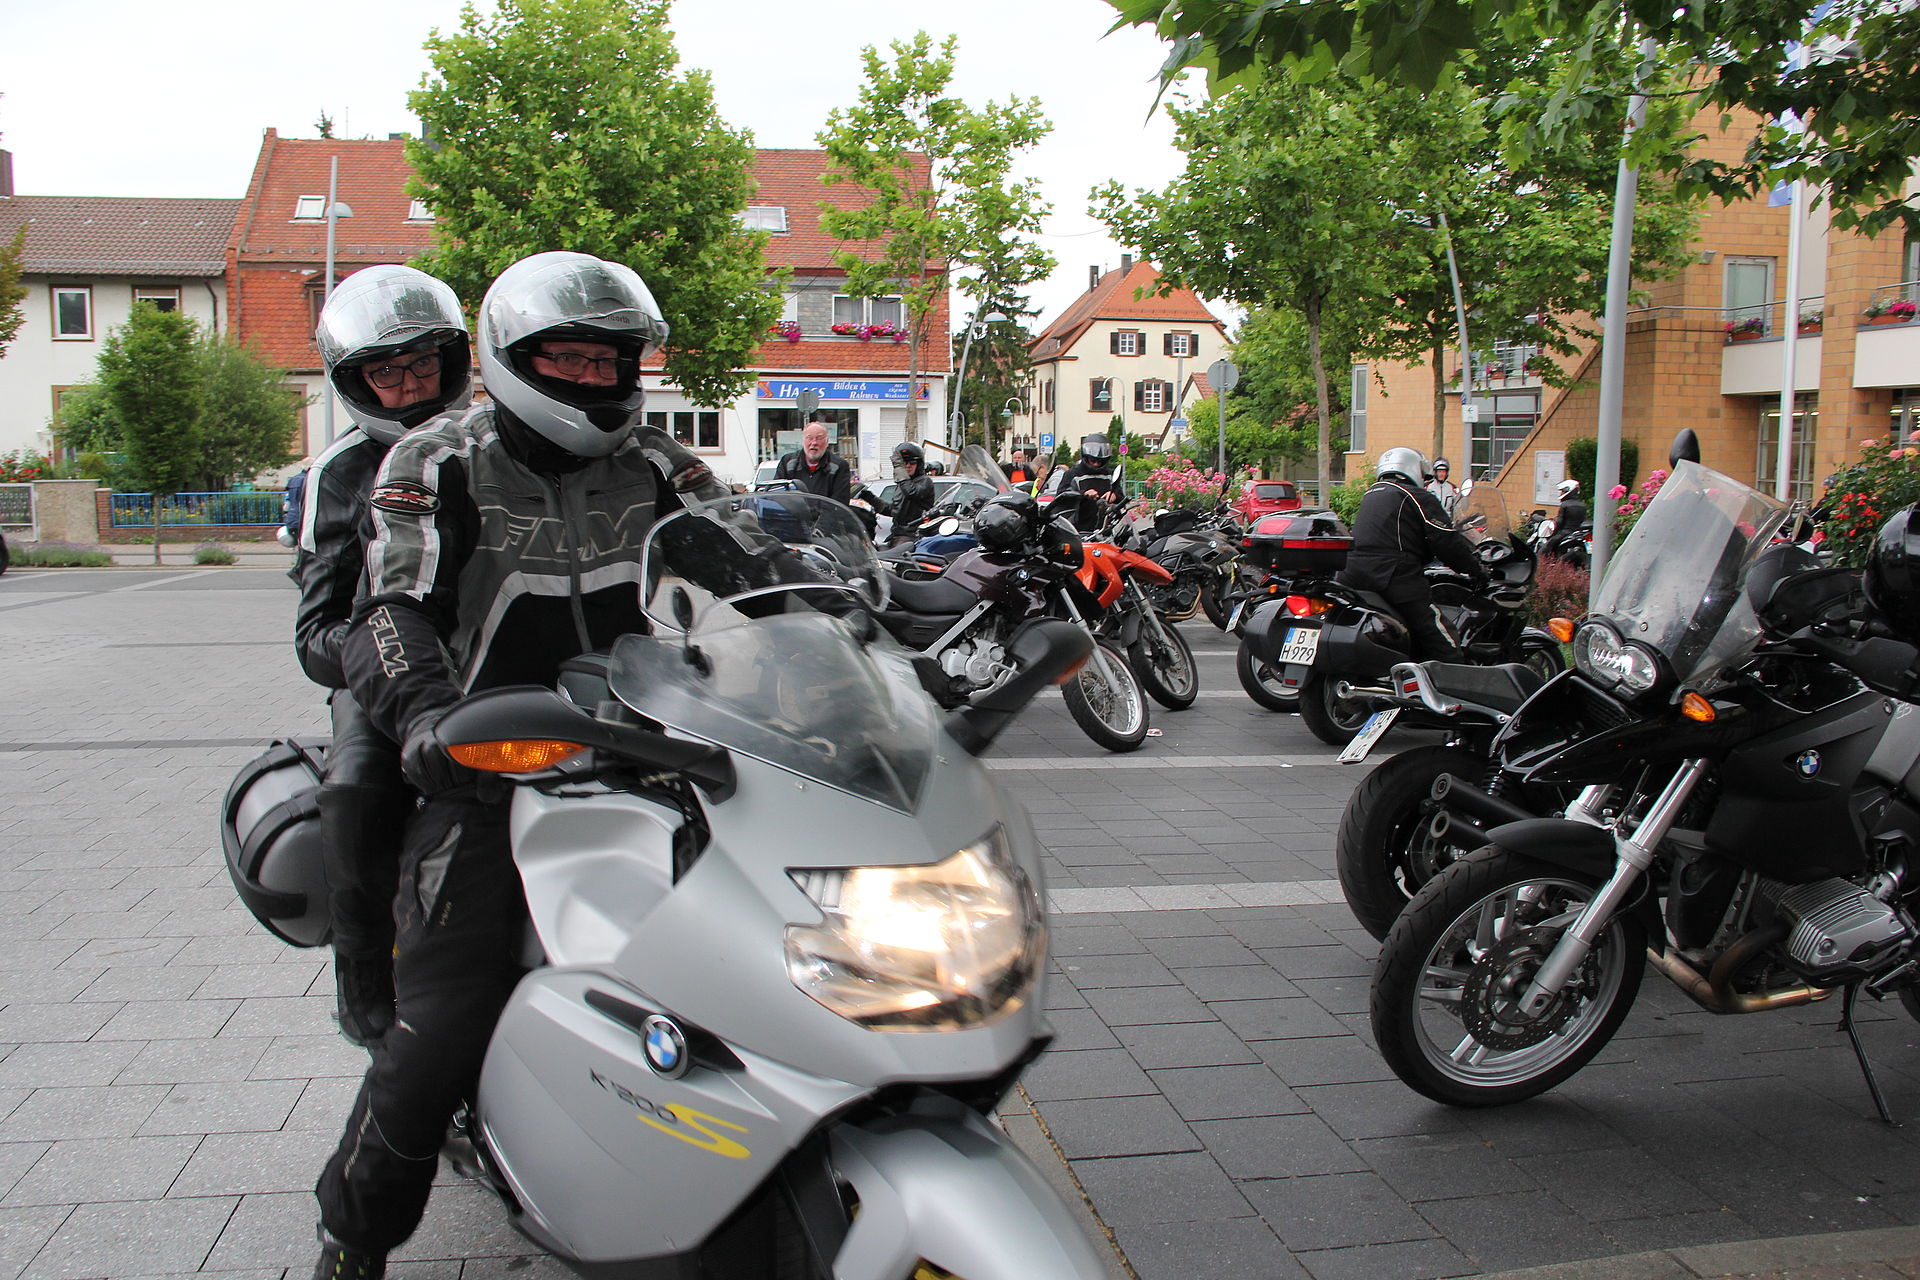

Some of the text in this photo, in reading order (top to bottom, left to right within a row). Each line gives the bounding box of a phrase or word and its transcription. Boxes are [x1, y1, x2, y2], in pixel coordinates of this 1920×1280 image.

[860, 383, 867, 391] &
[1043, 435, 1051, 446] P
[368, 605, 410, 679] FLM
[1297, 630, 1307, 645] B
